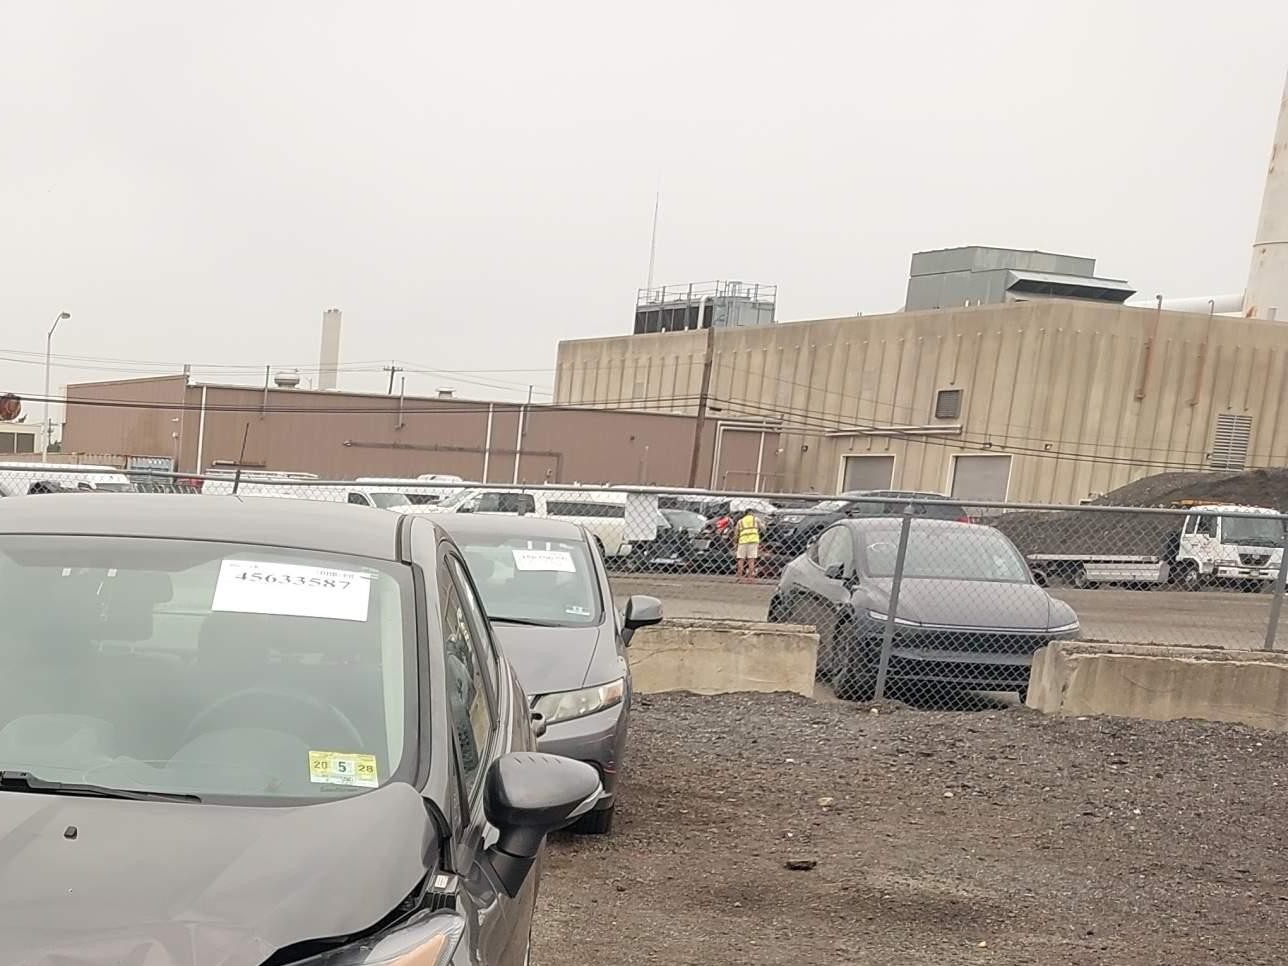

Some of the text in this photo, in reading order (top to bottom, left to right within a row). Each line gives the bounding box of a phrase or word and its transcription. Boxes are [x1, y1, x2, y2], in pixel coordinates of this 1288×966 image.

[234, 571, 352, 590] 45633587
[313, 760, 328, 770] 20
[338, 761, 347, 773] 5
